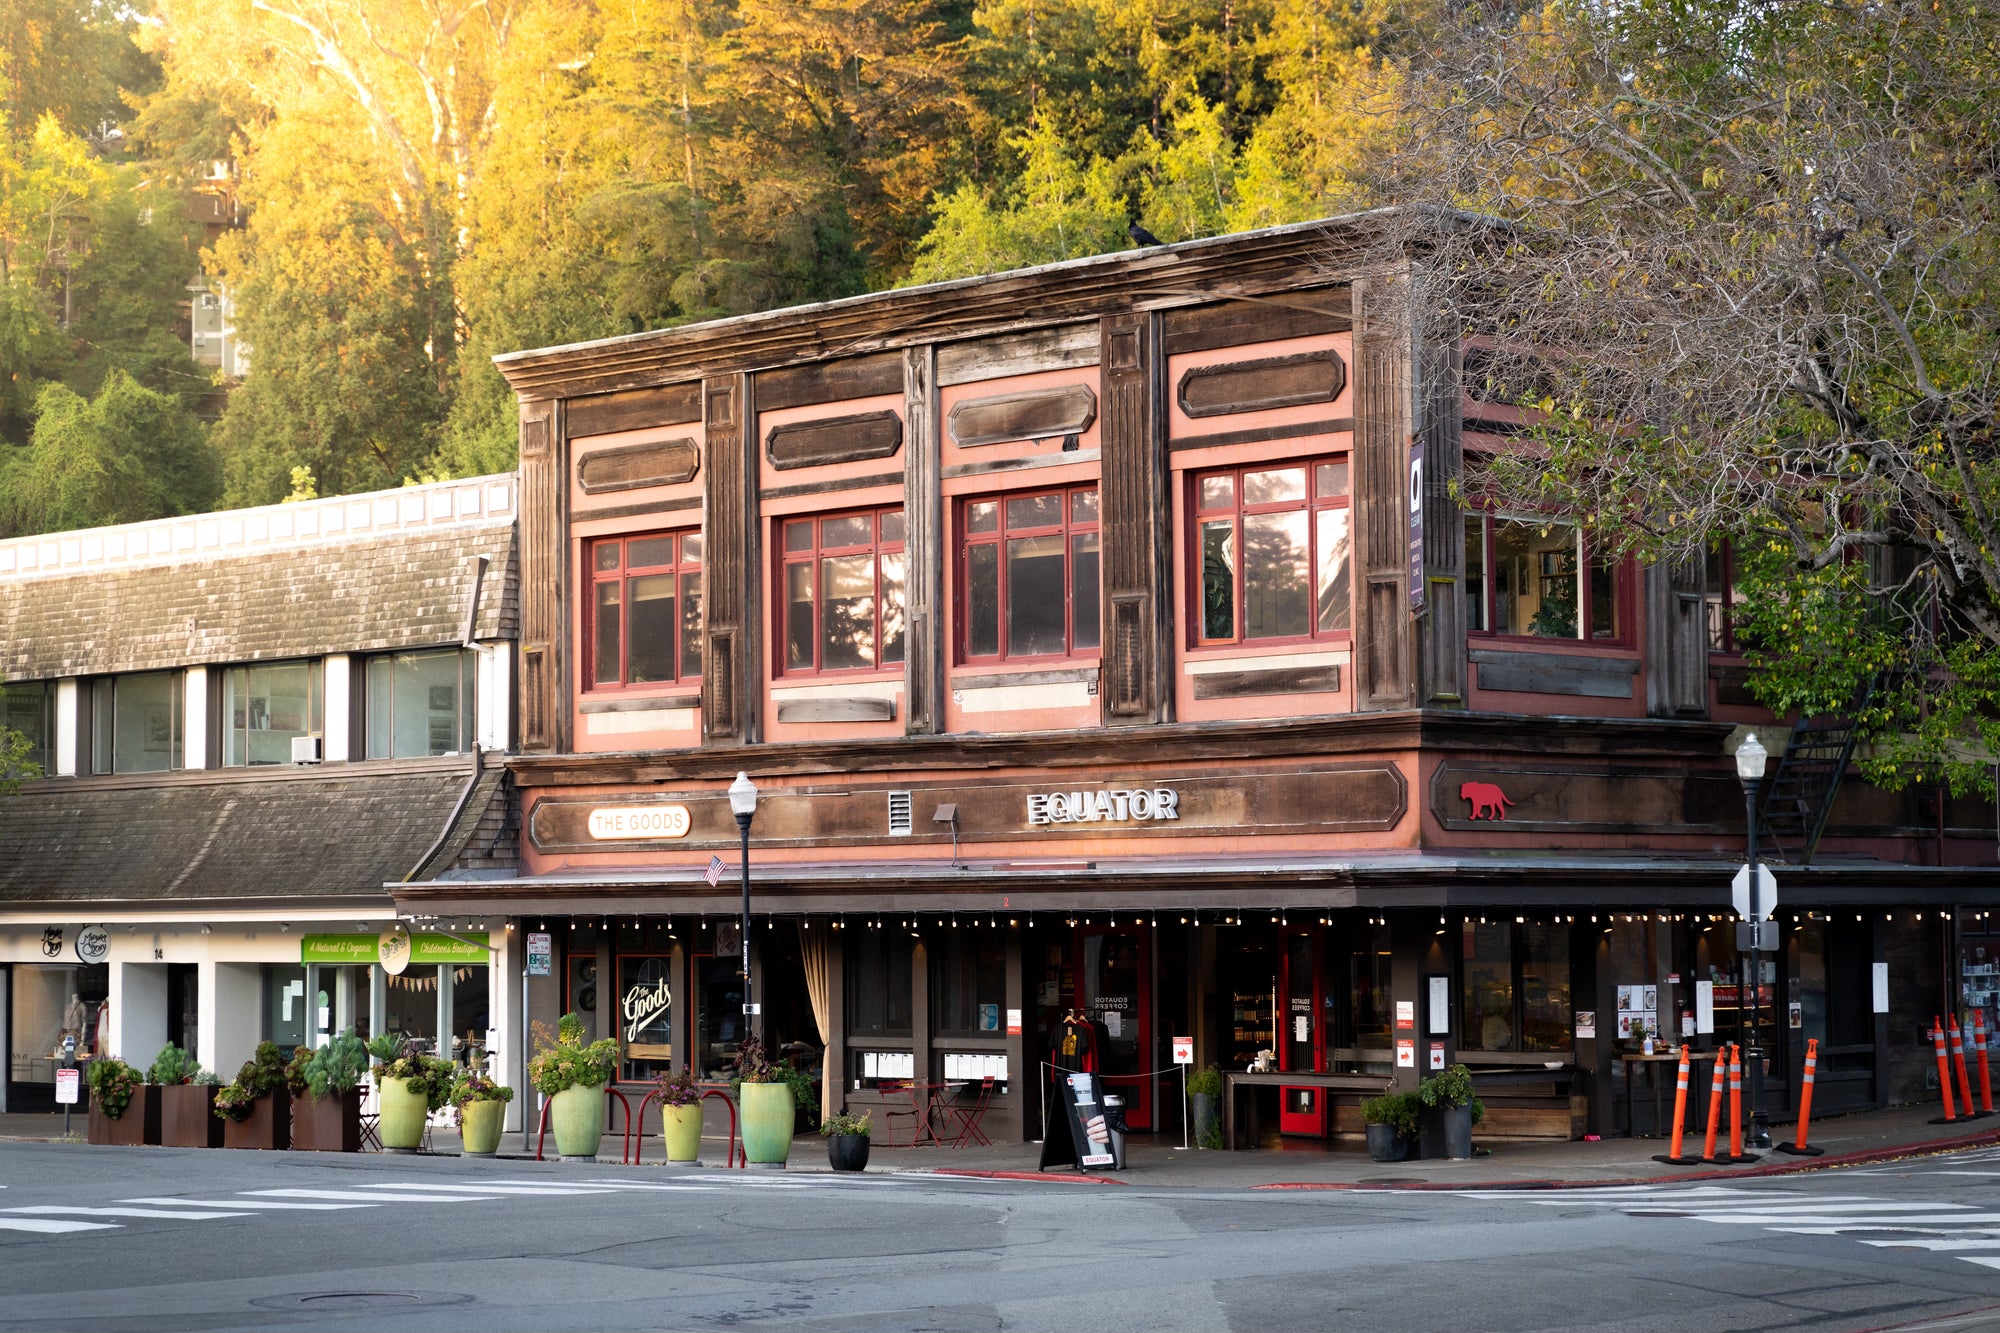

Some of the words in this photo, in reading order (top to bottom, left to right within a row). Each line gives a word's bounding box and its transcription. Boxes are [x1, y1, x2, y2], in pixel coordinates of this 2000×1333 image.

[1026, 788, 1179, 825] EQUATOR
[595, 815, 623, 831] THE
[629, 813, 683, 830] GOODS
[1003, 896, 1010, 908] 2
[155, 948, 163, 959] 14
[315, 942, 340, 952] Natural
[347, 942, 372, 958] Organic
[421, 942, 451, 954] Children's
[452, 942, 479, 957] Boutique
[622, 977, 671, 1042] Goods
[1085, 1156, 1110, 1164] EQUATOR
